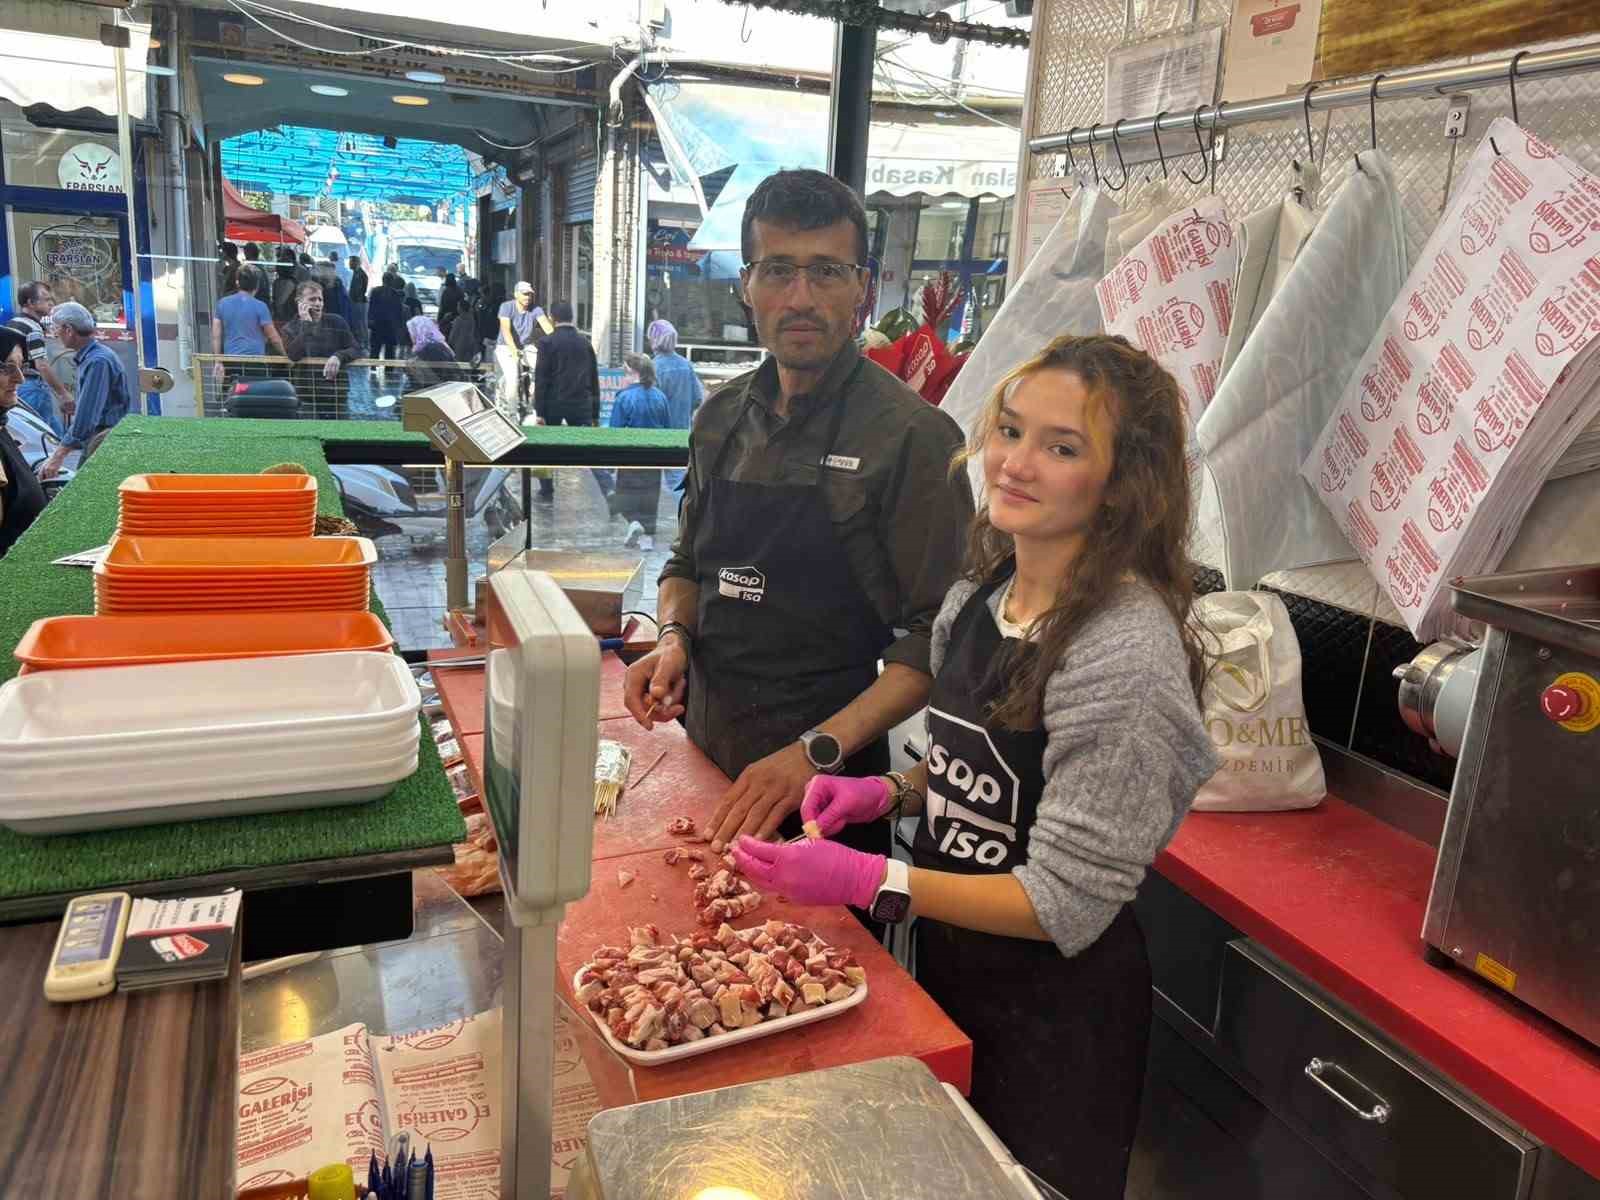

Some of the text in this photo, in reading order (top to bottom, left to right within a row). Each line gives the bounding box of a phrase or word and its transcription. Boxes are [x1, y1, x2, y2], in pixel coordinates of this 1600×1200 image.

[927, 733, 1001, 804] sap
[1218, 754, 1296, 774] ZDEMİR
[240, 1082, 313, 1119] GALERİSİ
[398, 1106, 468, 1128] GALERİSİ
